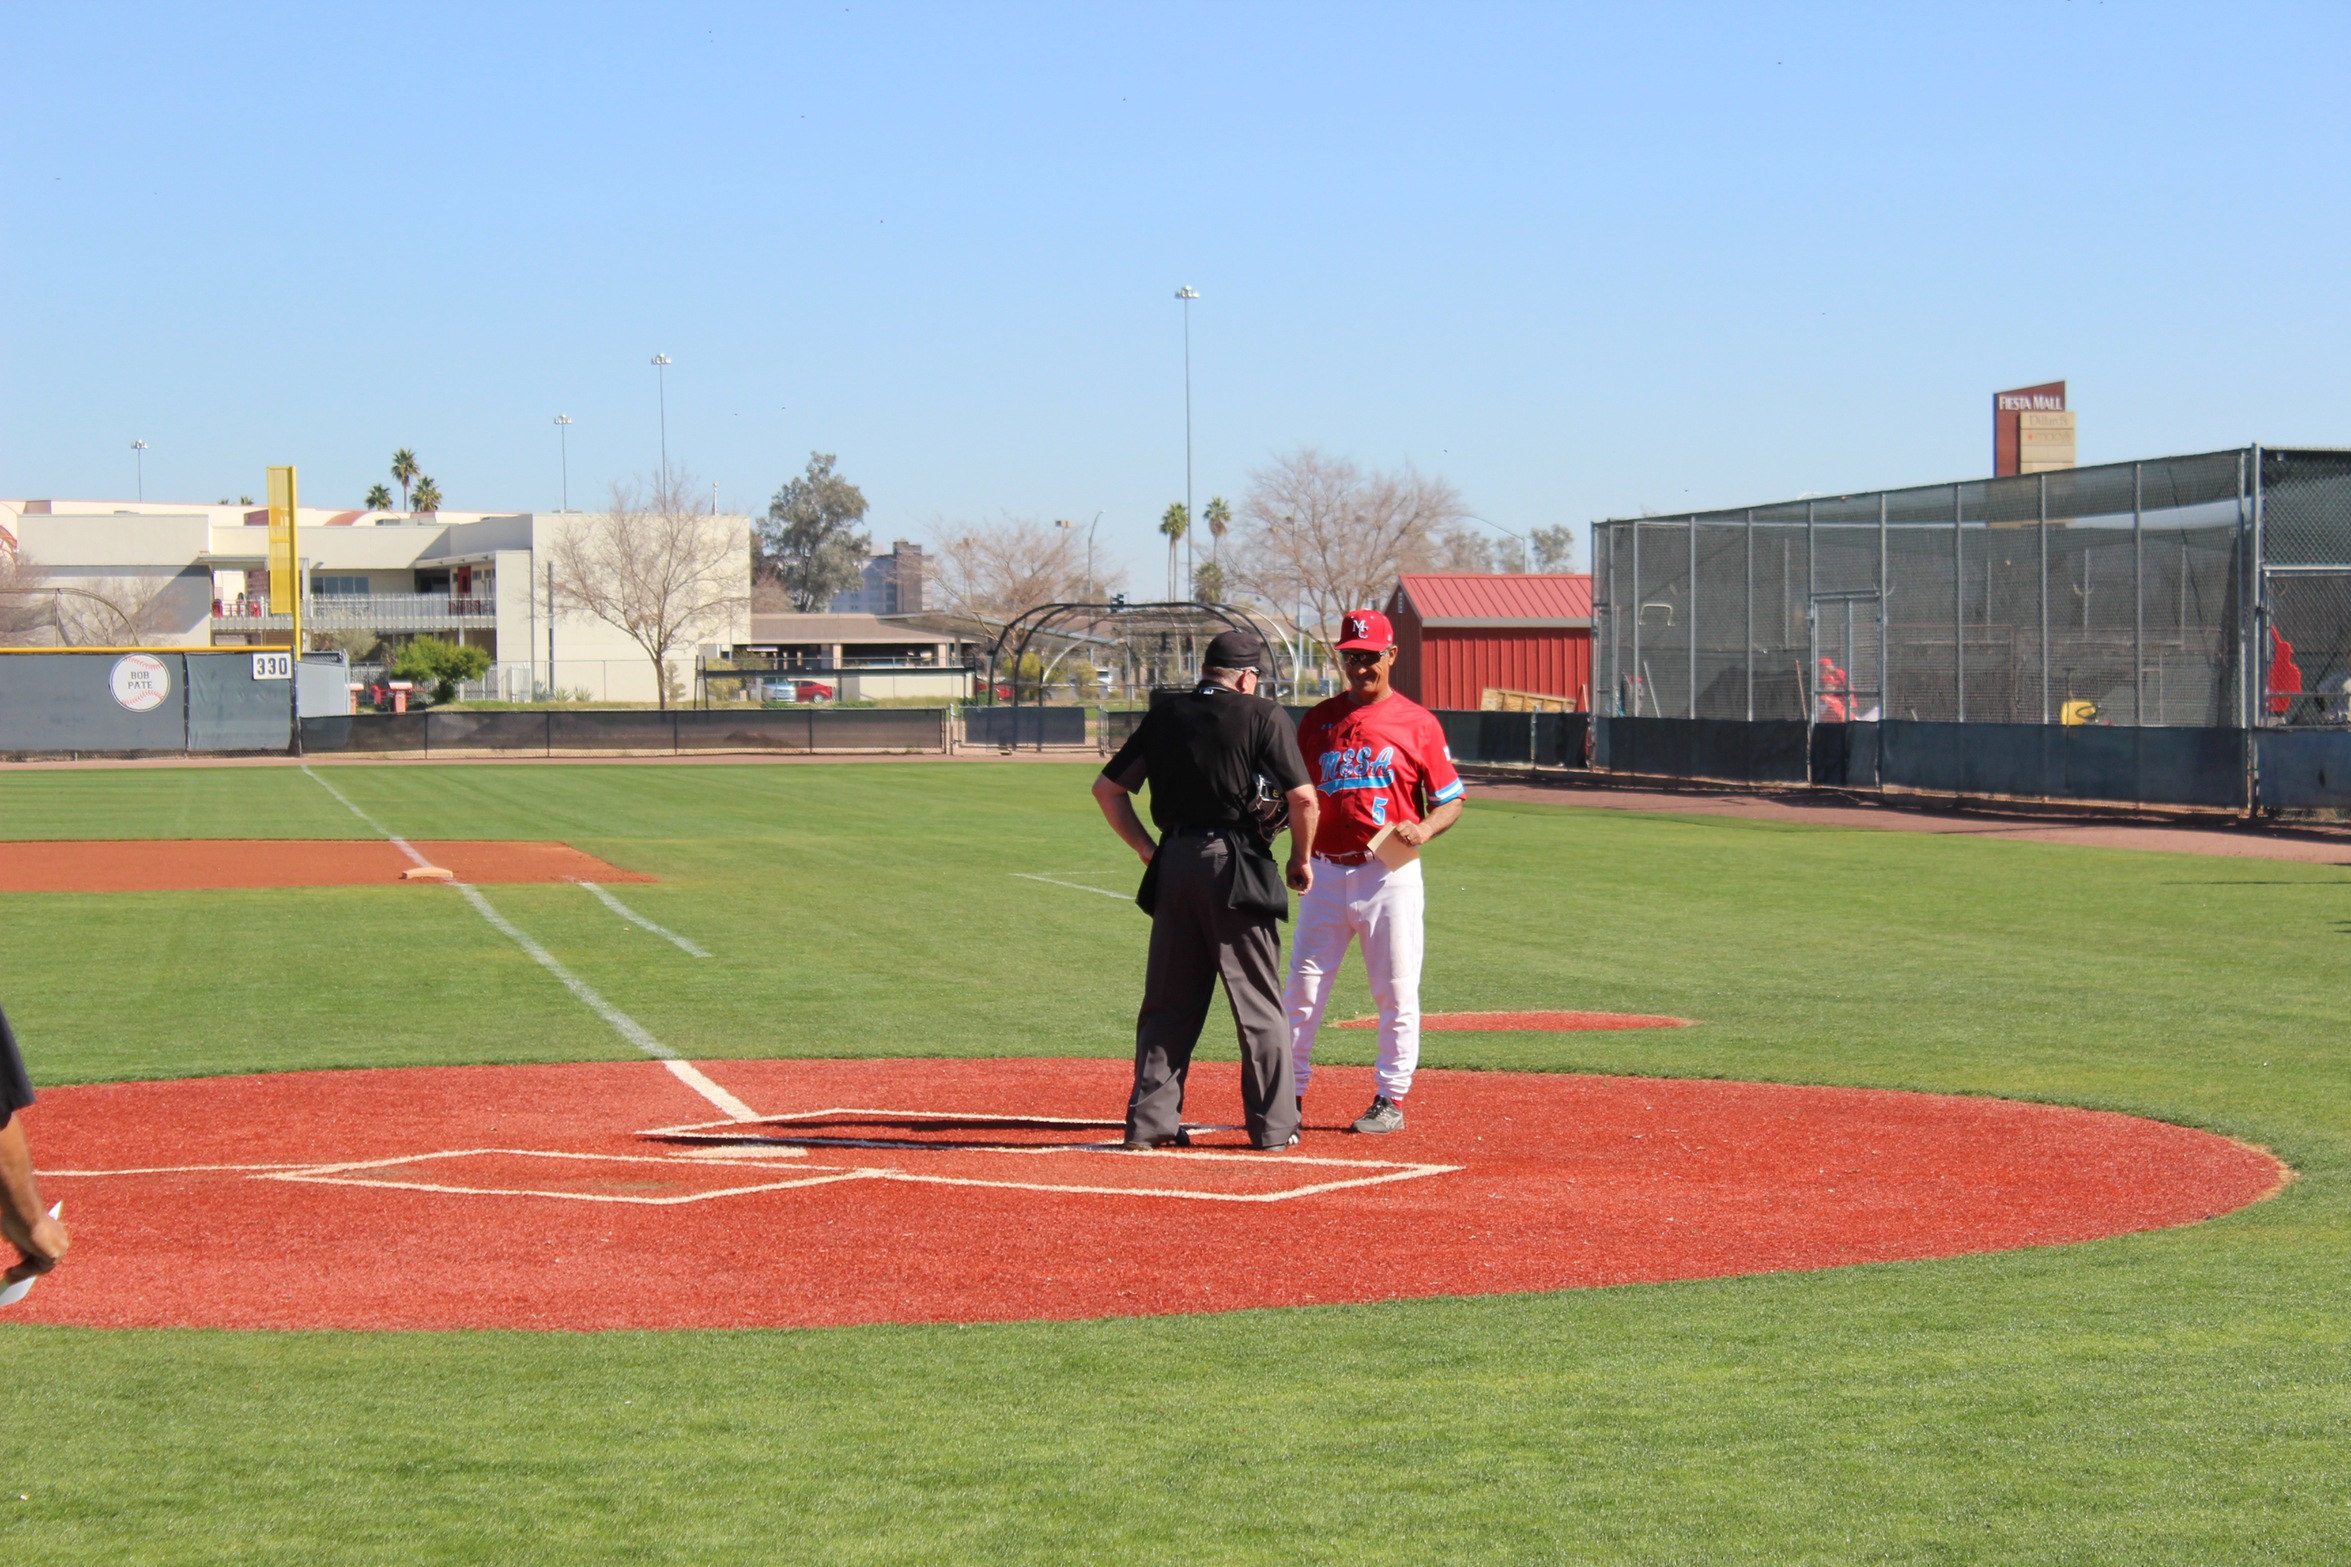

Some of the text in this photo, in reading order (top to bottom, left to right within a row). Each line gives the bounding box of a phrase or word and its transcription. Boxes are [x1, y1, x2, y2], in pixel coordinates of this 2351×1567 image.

[1998, 394, 2063, 411] FIESTA MALL
[130, 670, 150, 680] BOB
[257, 656, 288, 676] 330
[127, 681, 153, 690] PATE
[1319, 746, 1394, 781] MESA
[1371, 795, 1389, 826] 5
